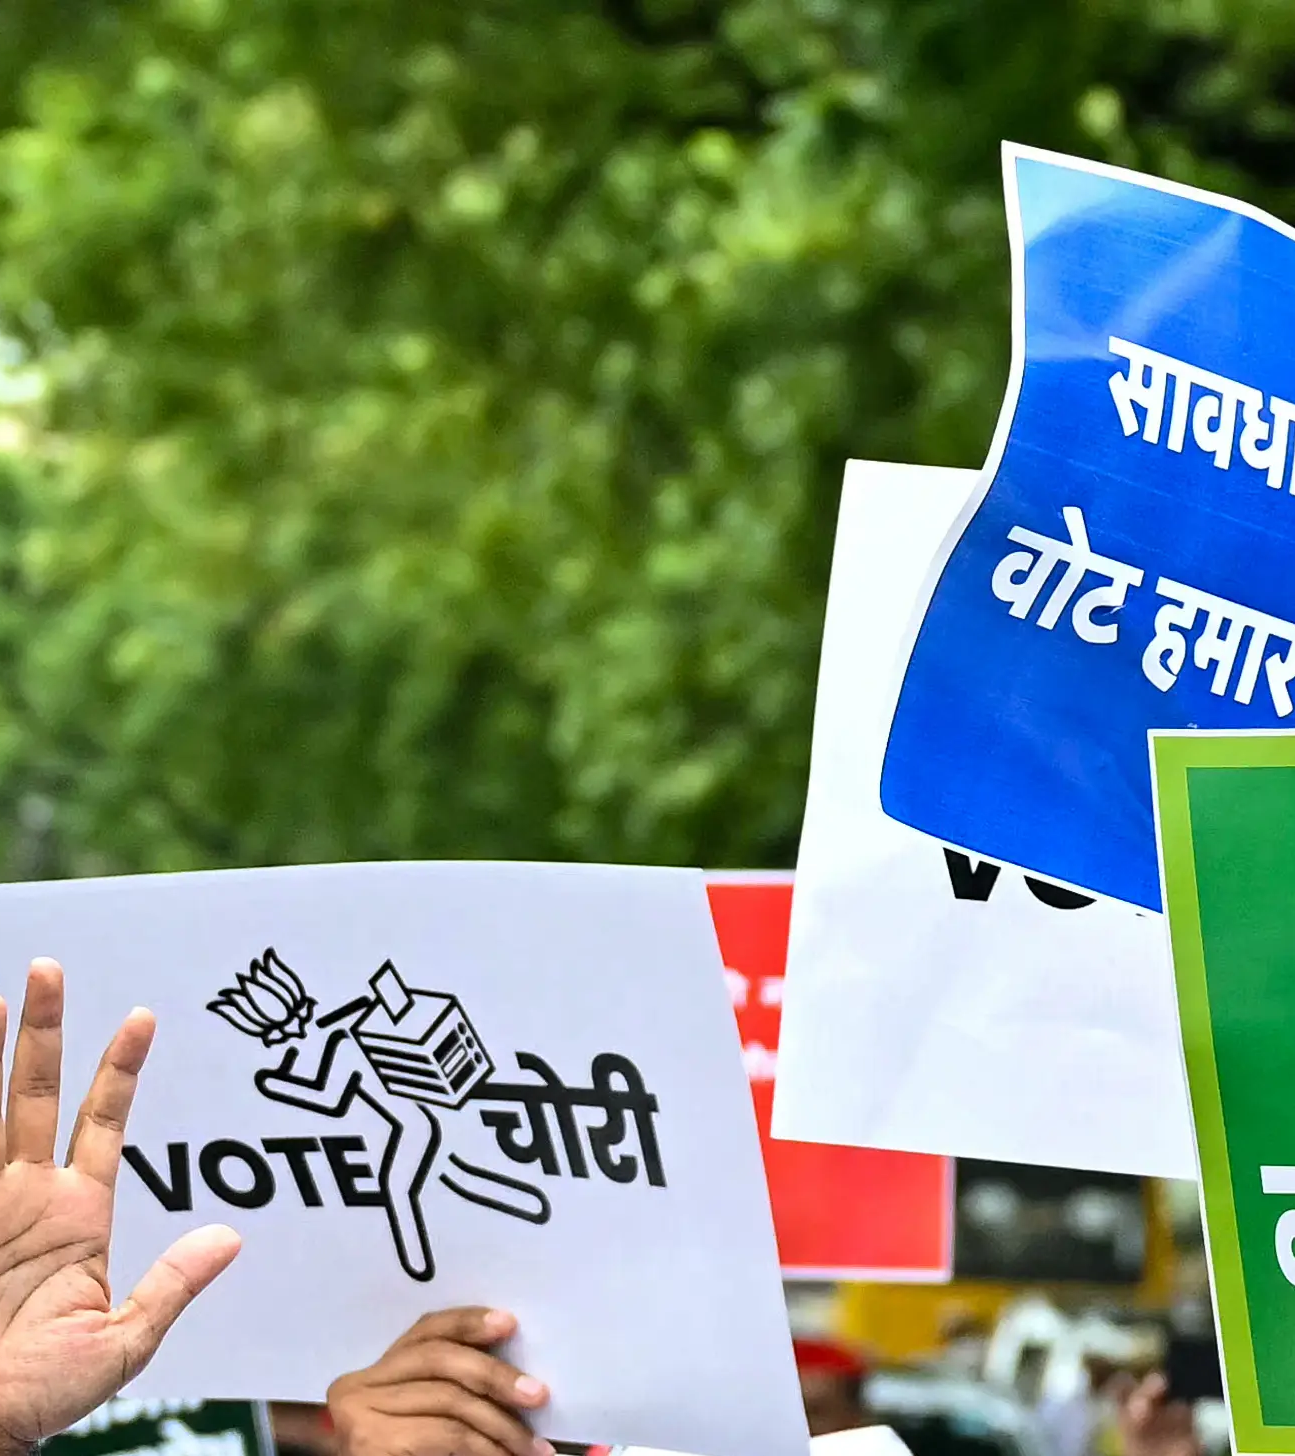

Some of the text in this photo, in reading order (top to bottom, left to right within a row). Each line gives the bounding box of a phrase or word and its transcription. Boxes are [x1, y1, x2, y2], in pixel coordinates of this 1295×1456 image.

[991, 507, 1145, 644] वोट
[121, 1136, 384, 1212] VOTE
[477, 1052, 666, 1187] चोरी
